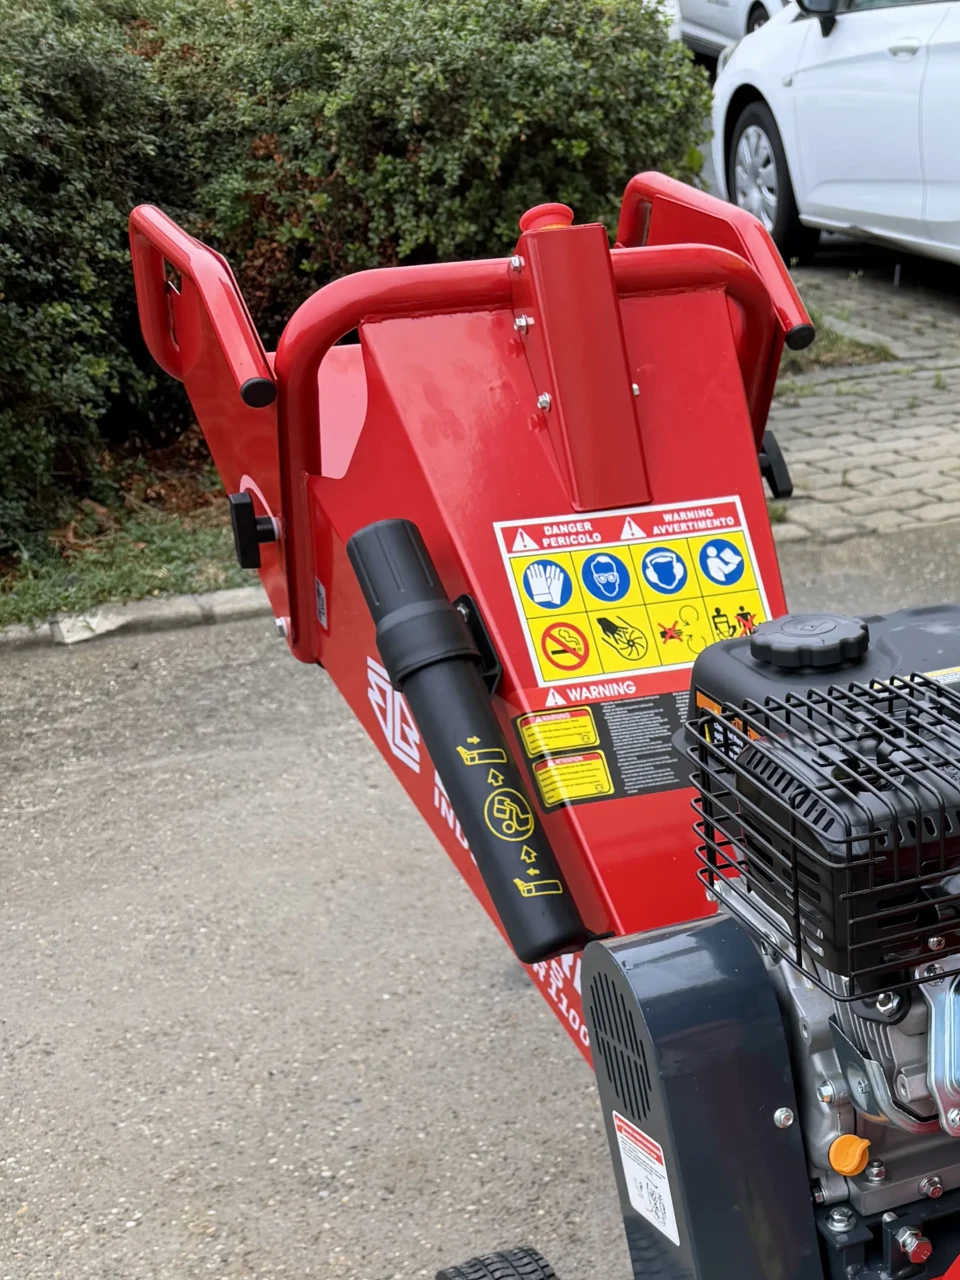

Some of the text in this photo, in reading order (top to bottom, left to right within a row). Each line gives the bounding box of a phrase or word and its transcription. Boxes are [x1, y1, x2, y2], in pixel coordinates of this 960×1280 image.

[663, 508, 714, 523] WARNING
[543, 521, 593, 536] DANGER
[652, 516, 735, 536] AVVERTIMENTO
[541, 532, 602, 548] PERICOLO
[566, 680, 637, 702] WARNING
